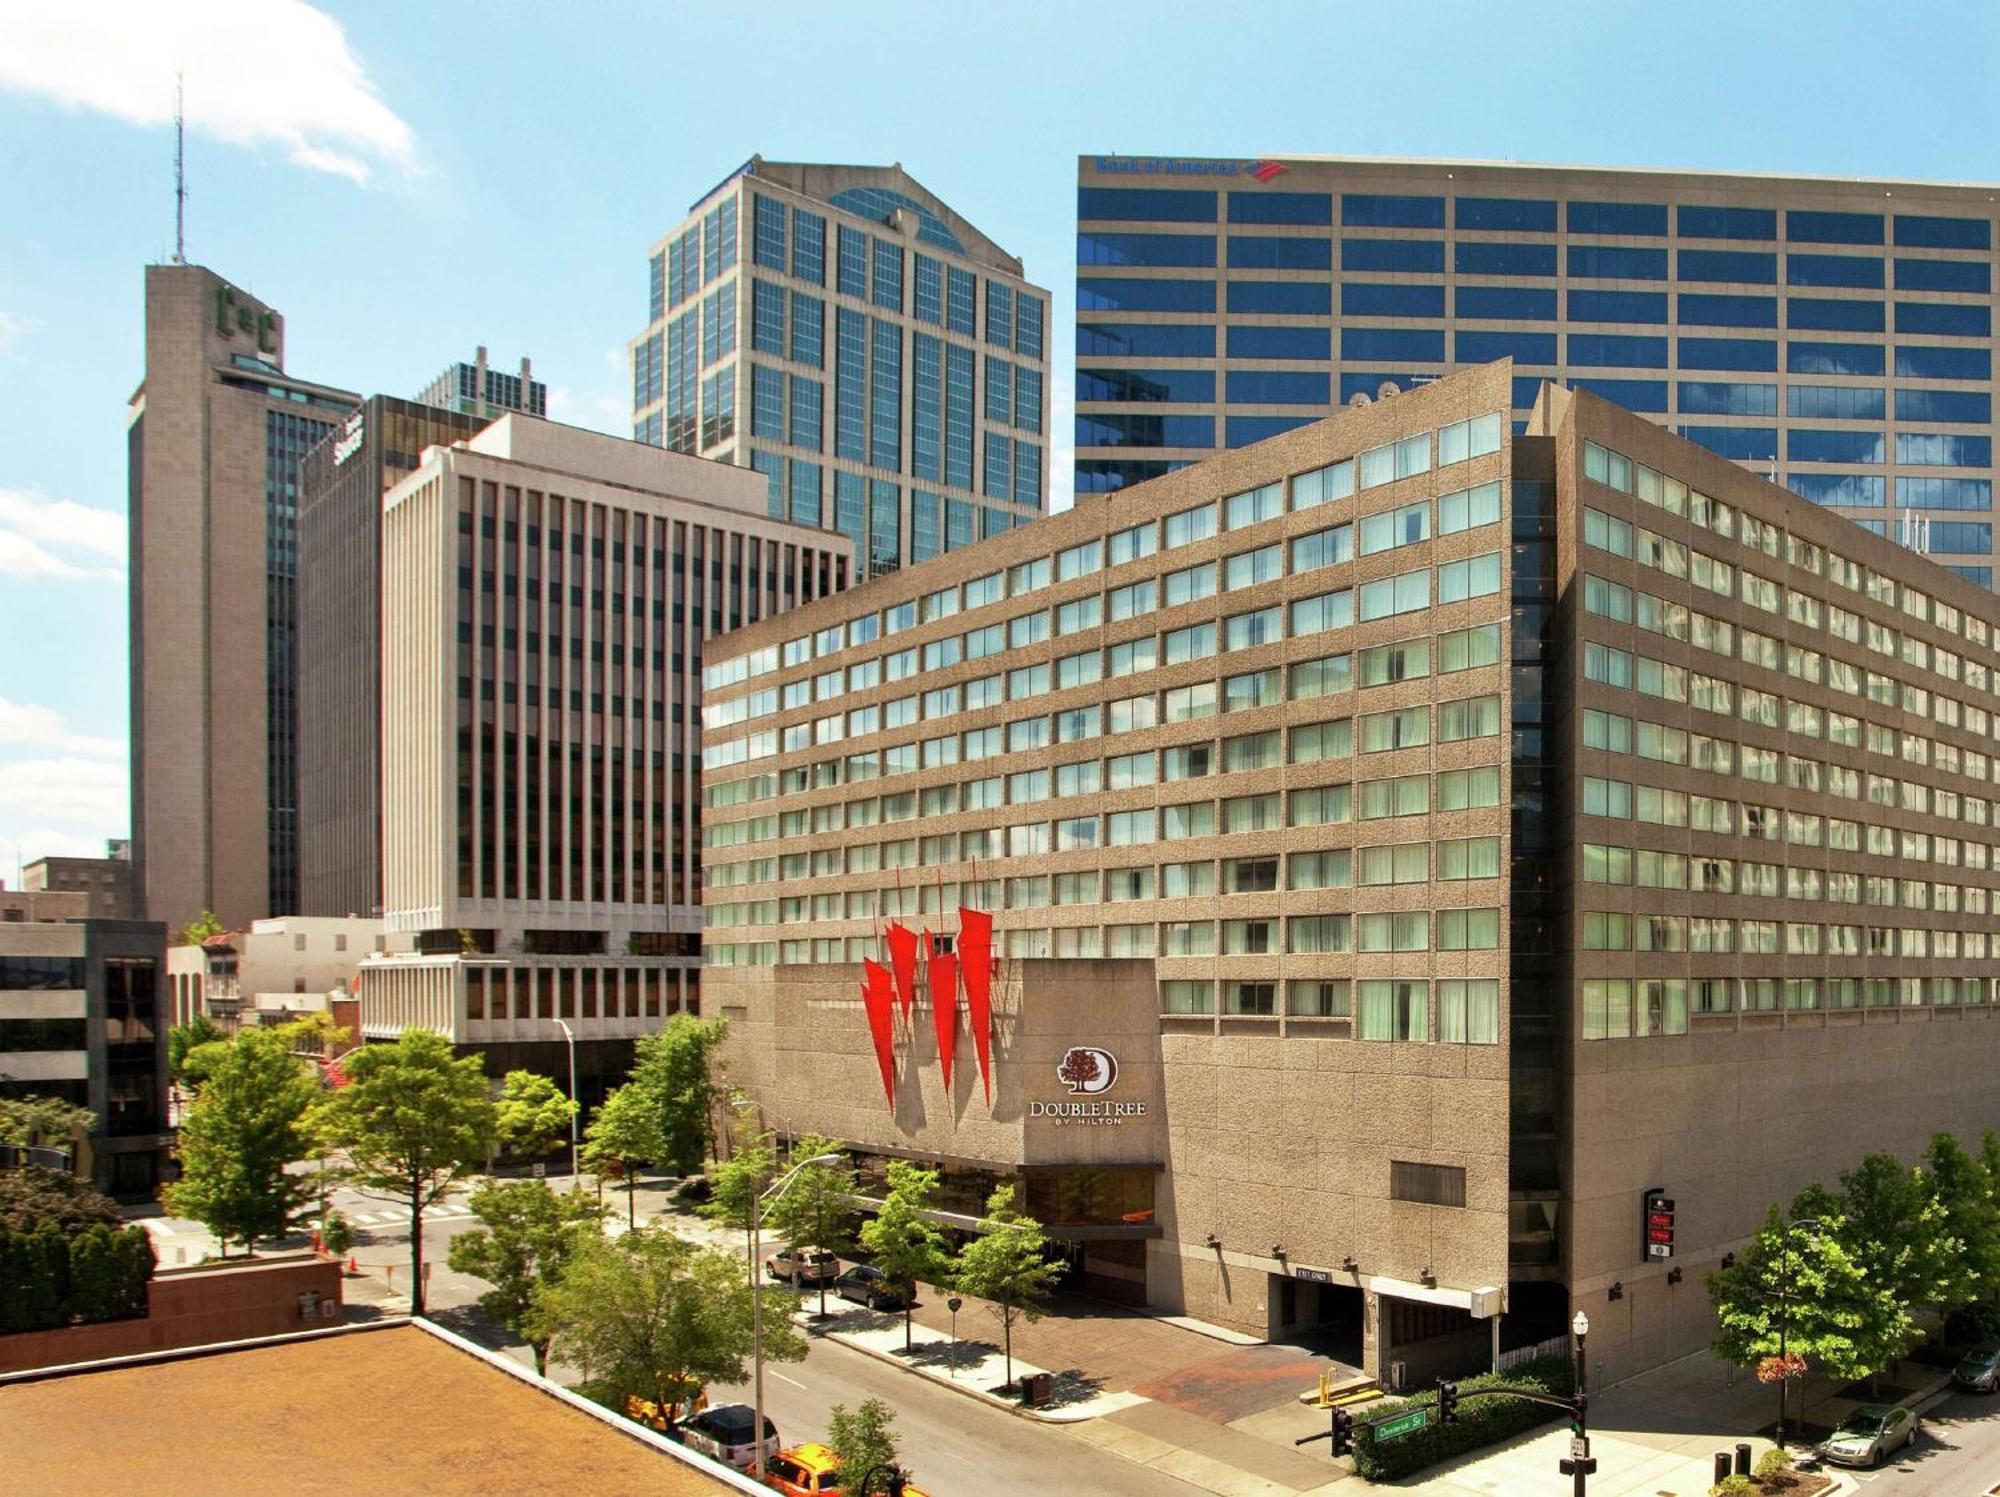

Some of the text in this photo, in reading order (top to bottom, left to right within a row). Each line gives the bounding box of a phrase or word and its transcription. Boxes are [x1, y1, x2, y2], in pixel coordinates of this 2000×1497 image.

[1096, 156, 1238, 176] Bank of America
[1055, 1117, 1122, 1126] BY HILTON
[1311, 1271, 1326, 1281] ONLY
[1412, 1416, 1422, 1427] St
